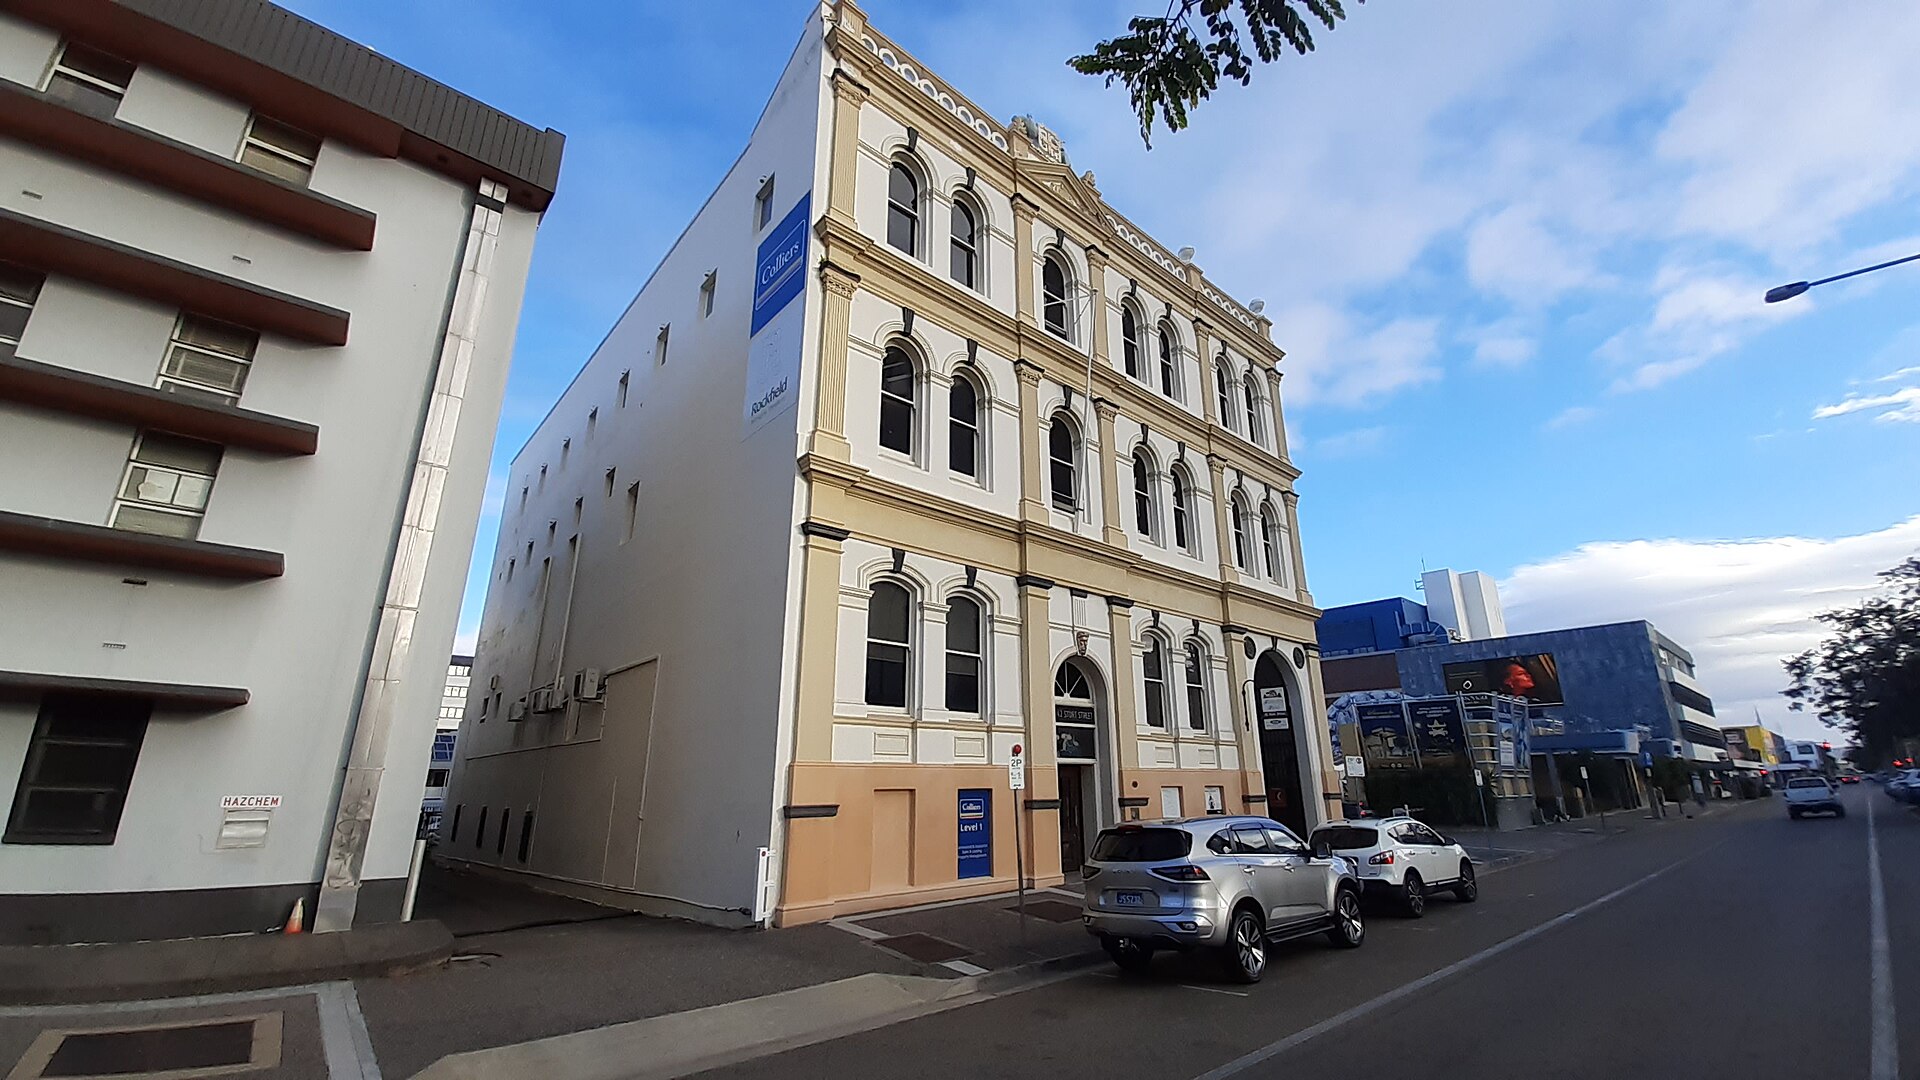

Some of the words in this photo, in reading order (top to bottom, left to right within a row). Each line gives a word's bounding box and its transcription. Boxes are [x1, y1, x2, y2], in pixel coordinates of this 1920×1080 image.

[761, 241, 799, 284] Colliers
[751, 376, 788, 417] Rockfield
[1010, 758, 1022, 767] 2P
[223, 797, 279, 806] HAZCHEM
[960, 822, 978, 832] Level
[979, 822, 983, 831] 1
